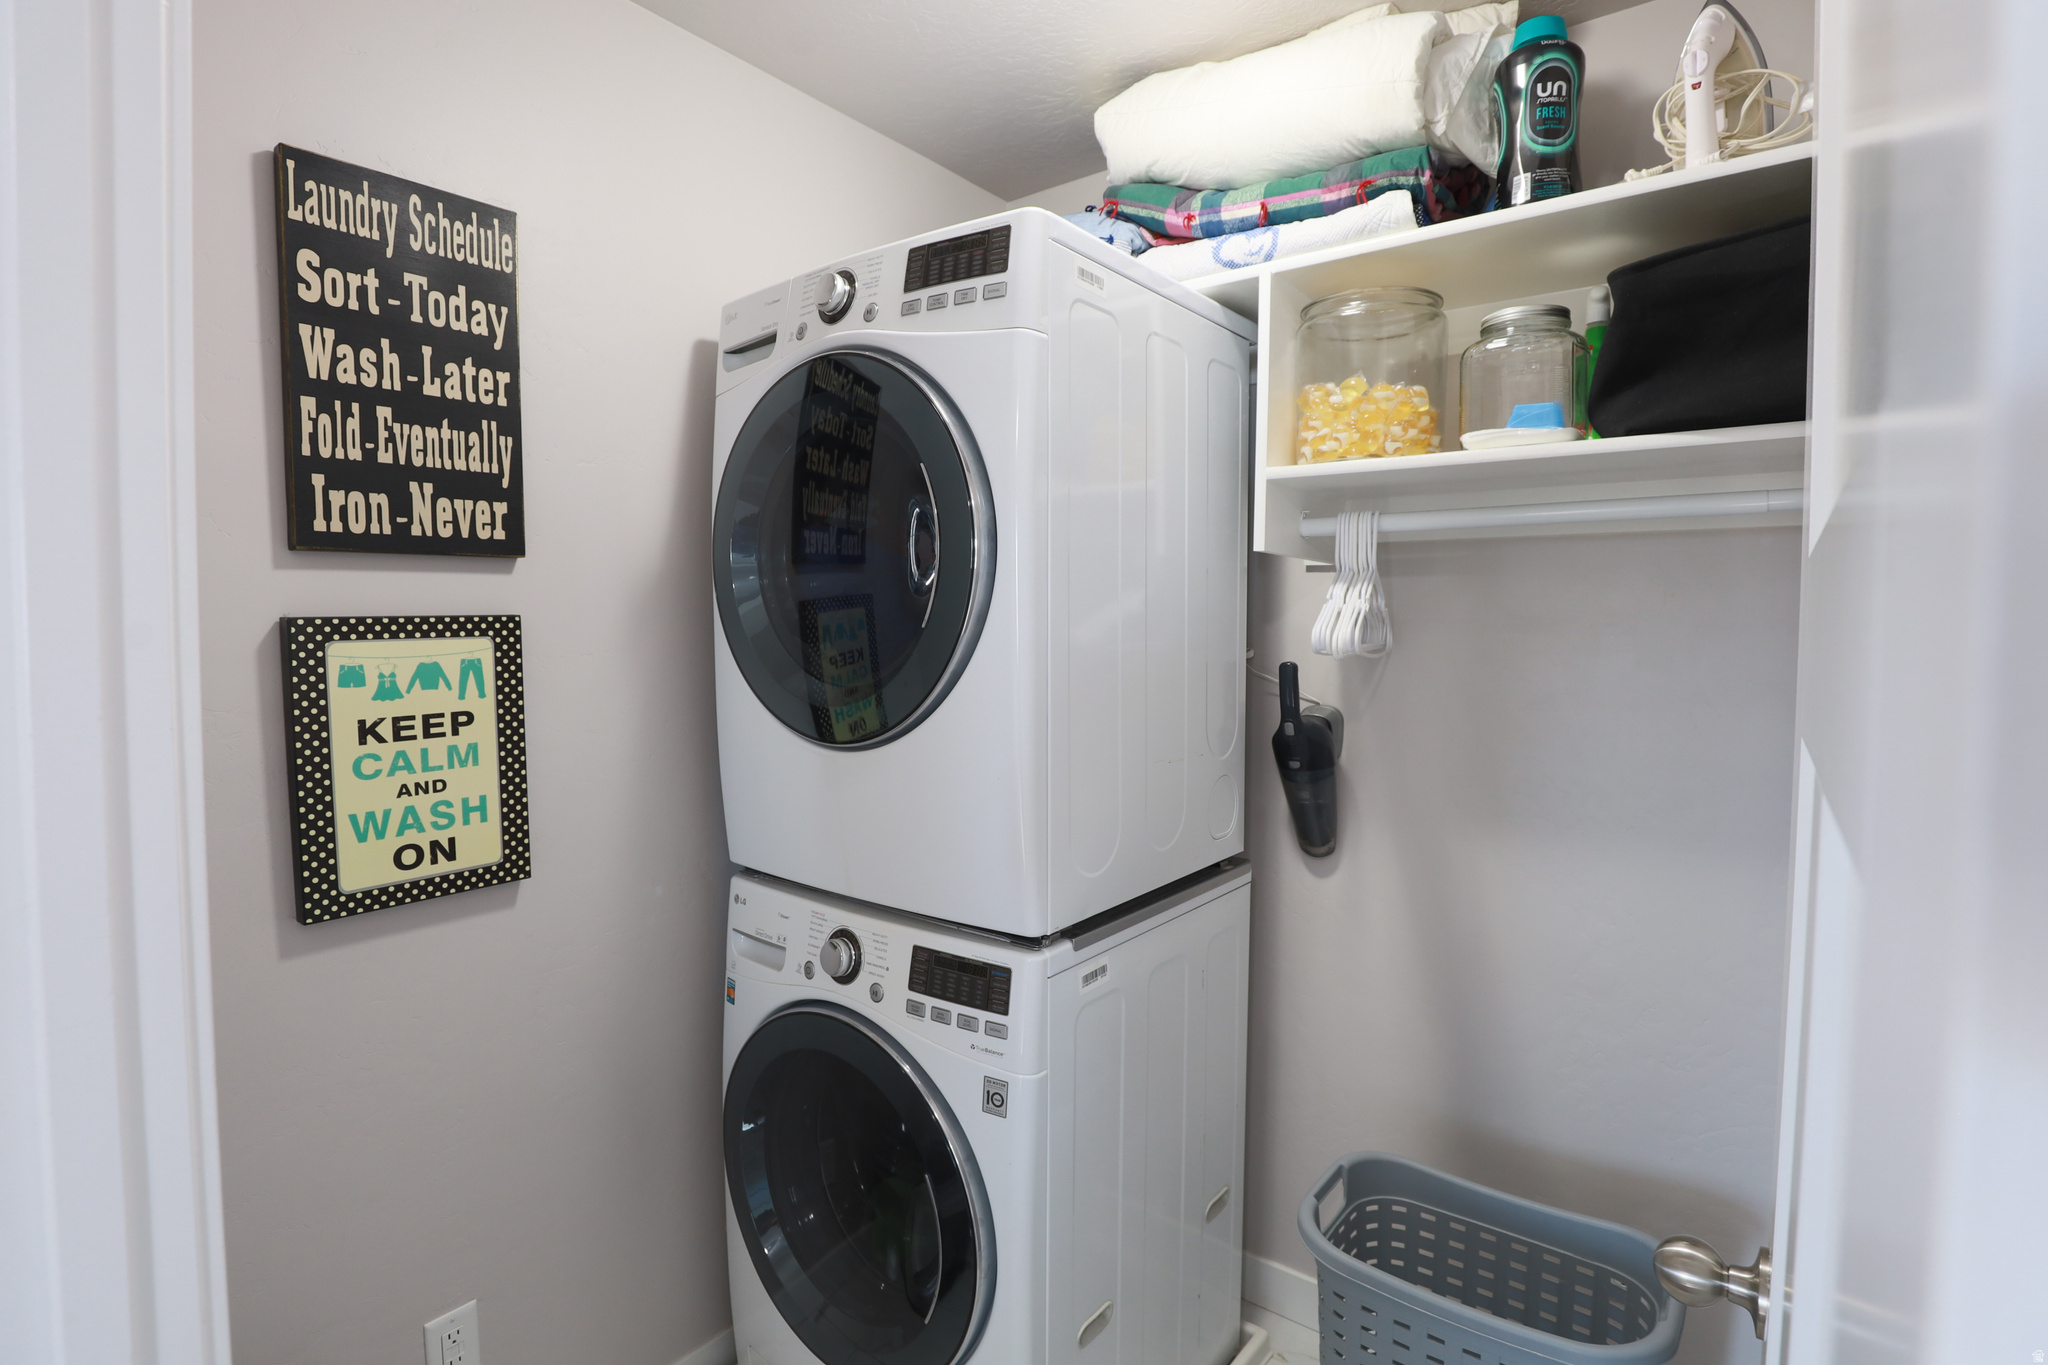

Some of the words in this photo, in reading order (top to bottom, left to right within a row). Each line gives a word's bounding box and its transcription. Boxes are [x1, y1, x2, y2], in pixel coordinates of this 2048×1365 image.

[1536, 105, 1567, 120] FRESH
[286, 158, 398, 259] Laundry
[408, 193, 514, 274] Schedule
[357, 710, 475, 746] KEEP
[351, 742, 480, 781] CALM
[396, 778, 448, 799] AND
[347, 794, 489, 844] WASH
[392, 836, 457, 871] ON
[986, 1089, 1005, 1109] 10
